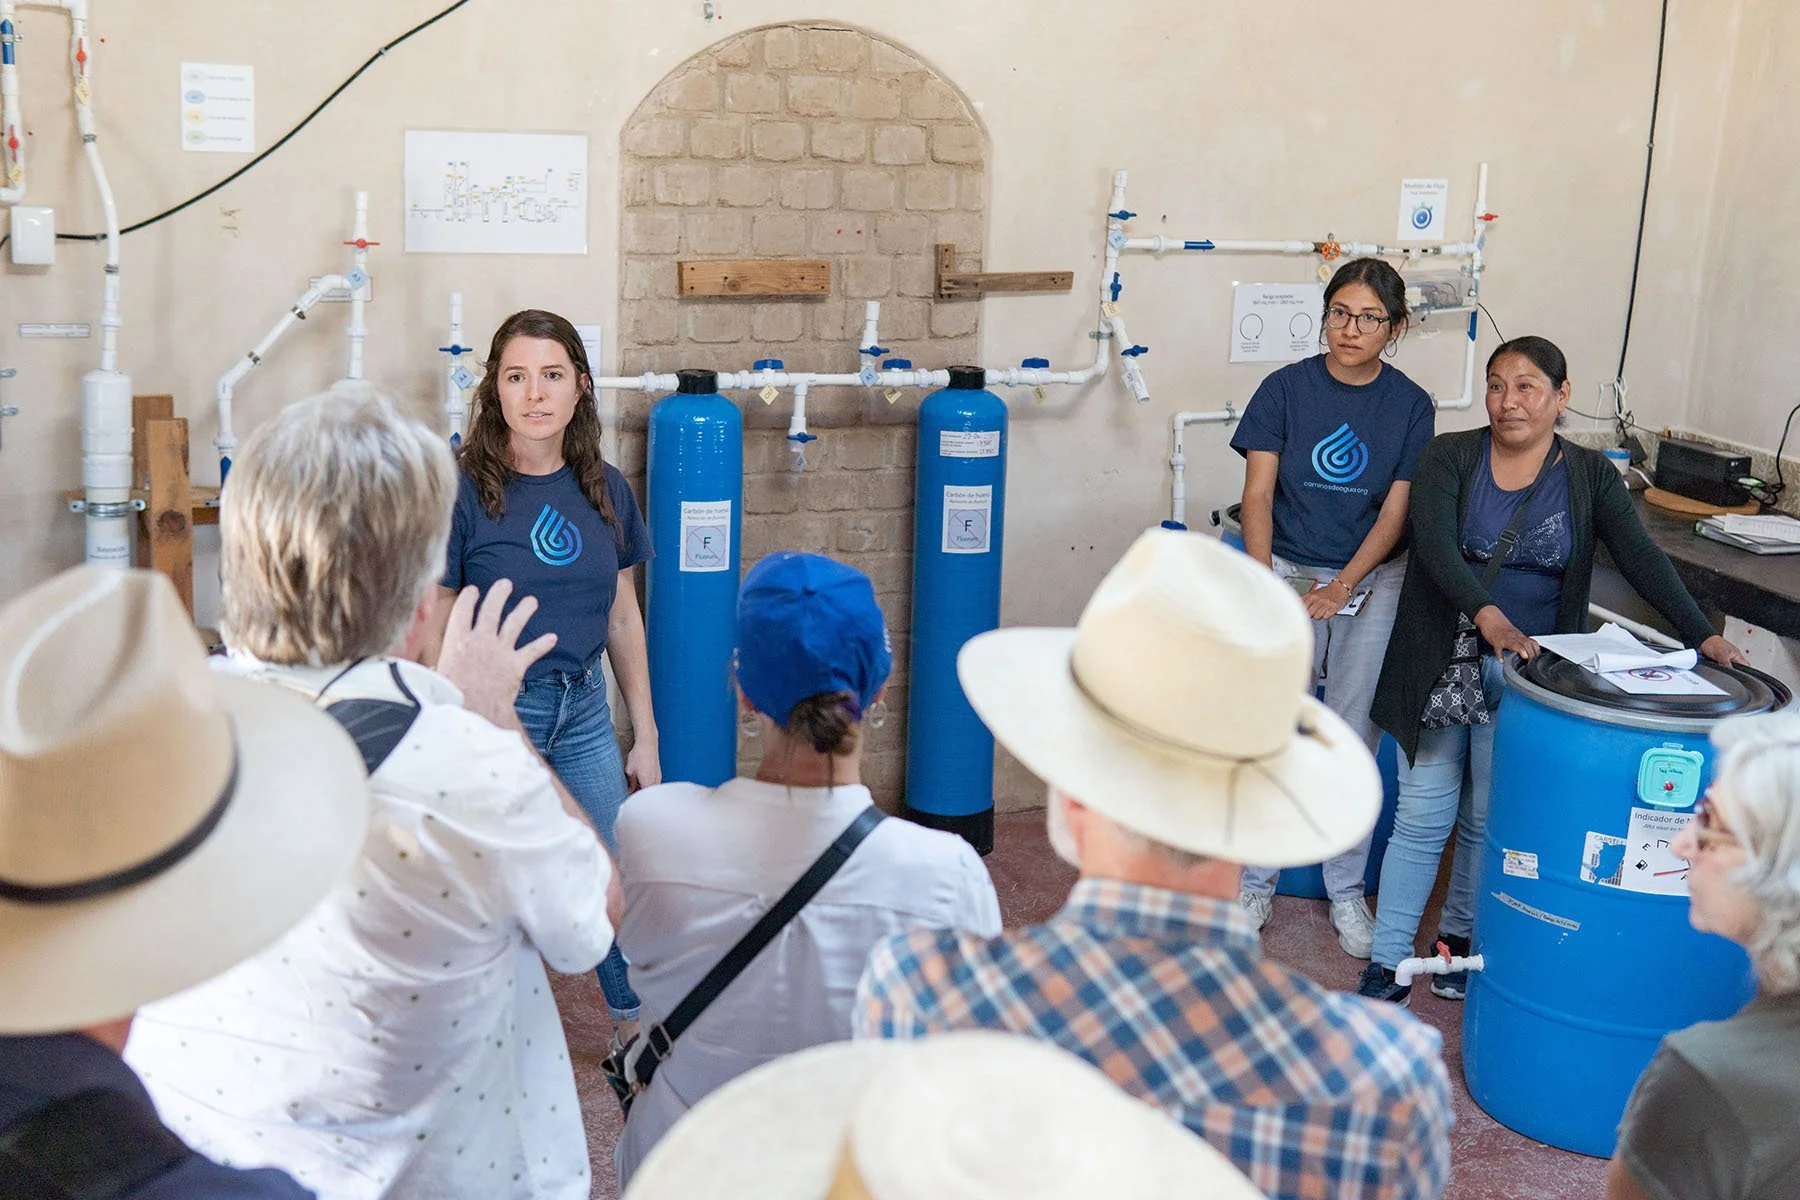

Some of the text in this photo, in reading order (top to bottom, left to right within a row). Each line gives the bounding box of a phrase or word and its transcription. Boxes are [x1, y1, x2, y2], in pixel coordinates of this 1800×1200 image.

[1303, 481, 1369, 495] caminosdeagua.org
[964, 519, 973, 532] F
[703, 536, 712, 549] F
[1634, 812, 1673, 823] Indicador
[1642, 843, 1651, 851] E
